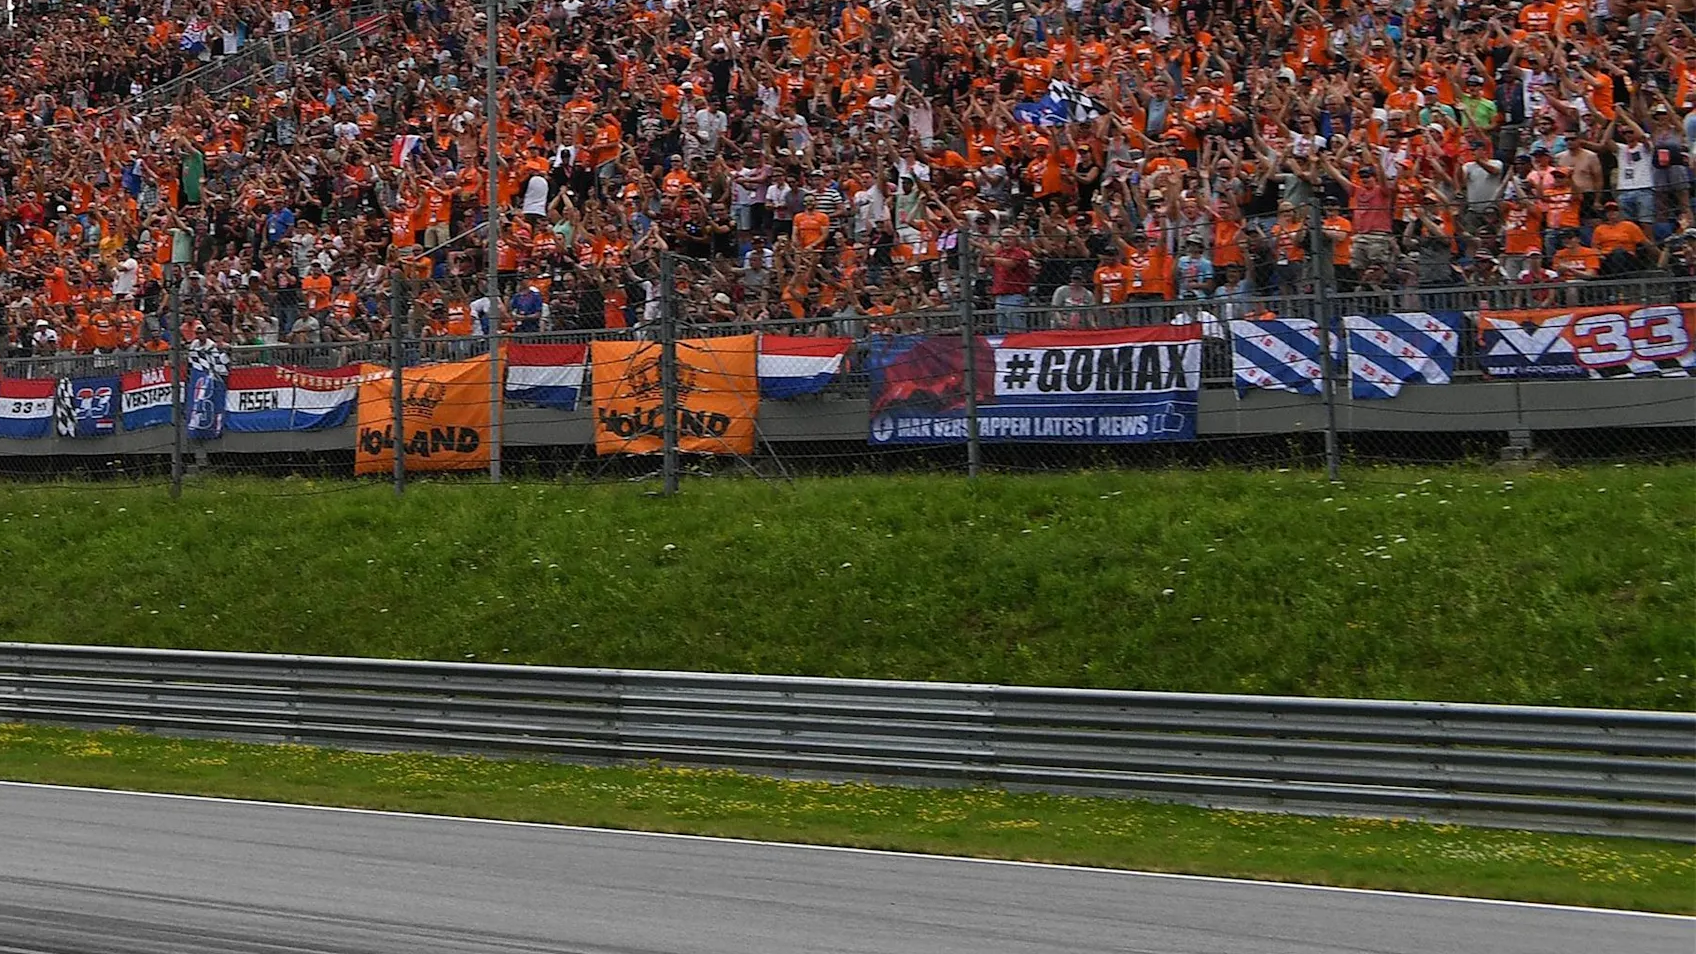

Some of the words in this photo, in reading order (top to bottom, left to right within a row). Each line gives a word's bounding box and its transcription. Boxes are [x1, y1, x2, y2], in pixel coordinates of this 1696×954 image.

[1573, 304, 1690, 365] 33
[1003, 345, 1190, 392] #GOMAX
[12, 402, 33, 413] 33
[239, 390, 278, 411] ASSEN
[1034, 417, 1095, 436] LATEST
[1098, 415, 1148, 436] NEWS
